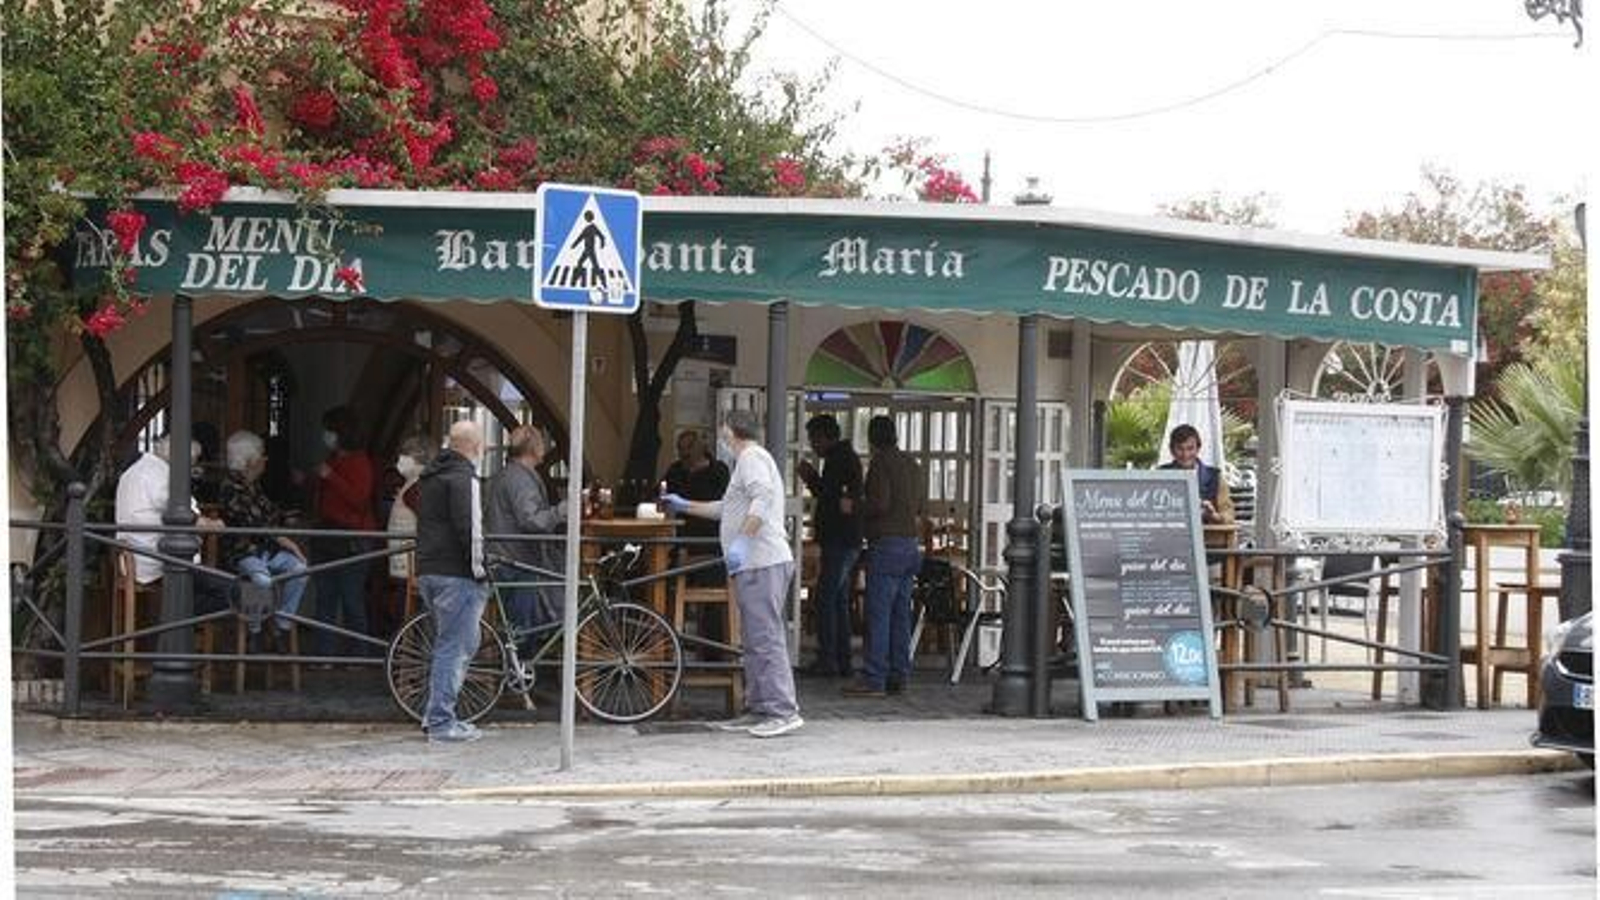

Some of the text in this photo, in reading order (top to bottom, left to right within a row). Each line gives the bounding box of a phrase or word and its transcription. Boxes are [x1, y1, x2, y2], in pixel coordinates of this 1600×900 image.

[180, 252, 268, 291] DEL
[435, 229, 536, 272] Bar
[639, 237, 757, 275] anta
[1043, 256, 1462, 328] PESCADO DE LA COSTA
